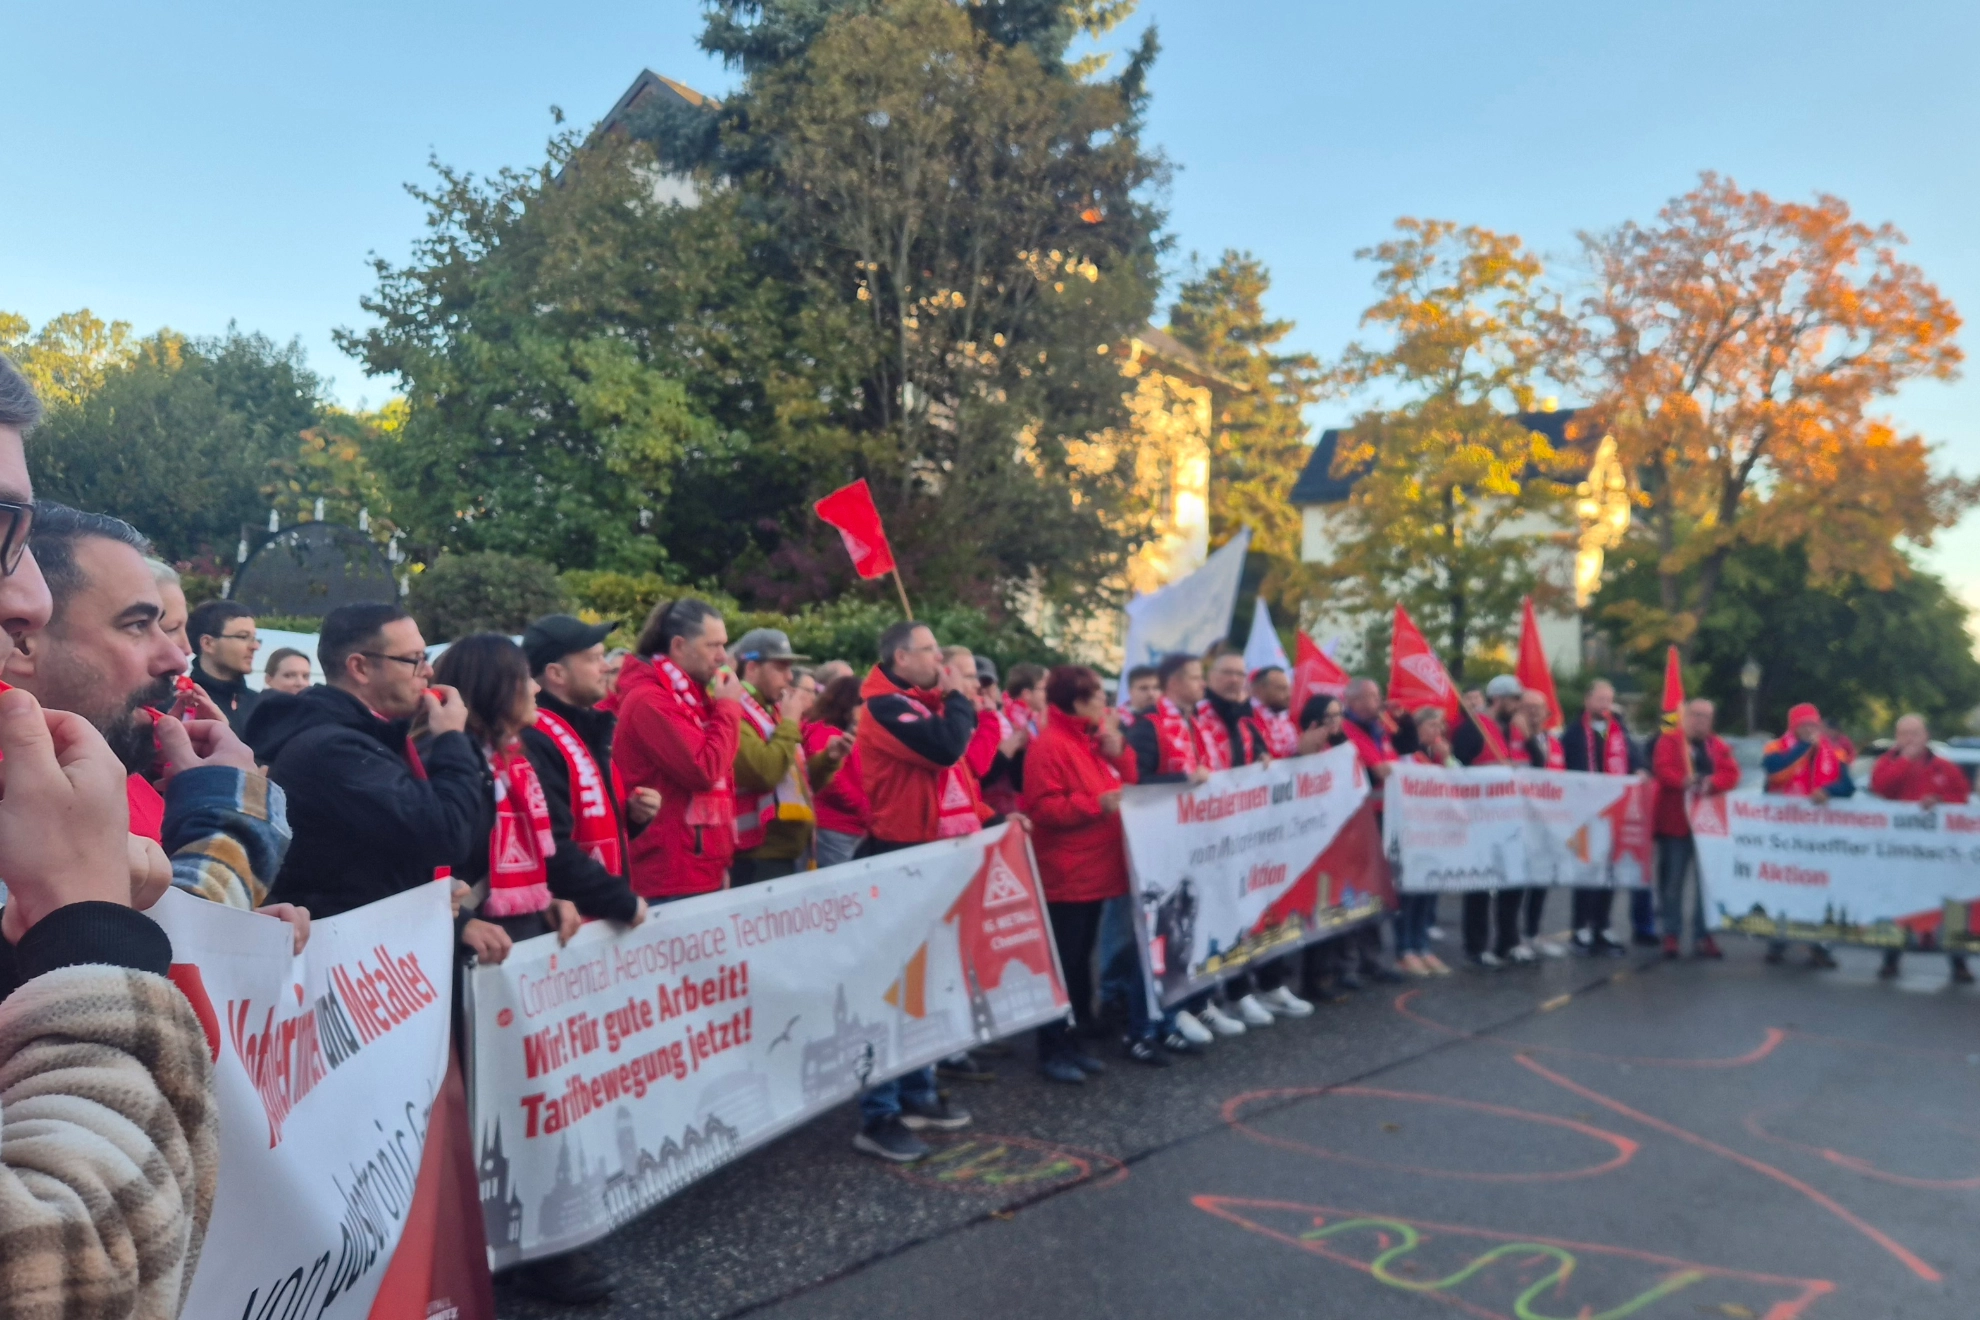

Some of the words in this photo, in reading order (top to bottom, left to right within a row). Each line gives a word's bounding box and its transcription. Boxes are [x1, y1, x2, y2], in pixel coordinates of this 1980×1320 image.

[1272, 773, 1293, 805] und
[1893, 812, 1937, 830] und
[1733, 857, 1751, 878] in
[1758, 860, 1830, 887] Aktion
[613, 925, 727, 984] Aerospace
[729, 891, 863, 949] Technologies
[315, 967, 361, 1070] und
[332, 944, 438, 1045] Metaller
[523, 1021, 568, 1080] Wir!
[567, 1011, 600, 1059] Für
[603, 996, 654, 1053] gute
[657, 959, 749, 1023] Arbeit!
[520, 1040, 688, 1139] Tarifbewegung
[685, 1006, 753, 1072] jetzt!
